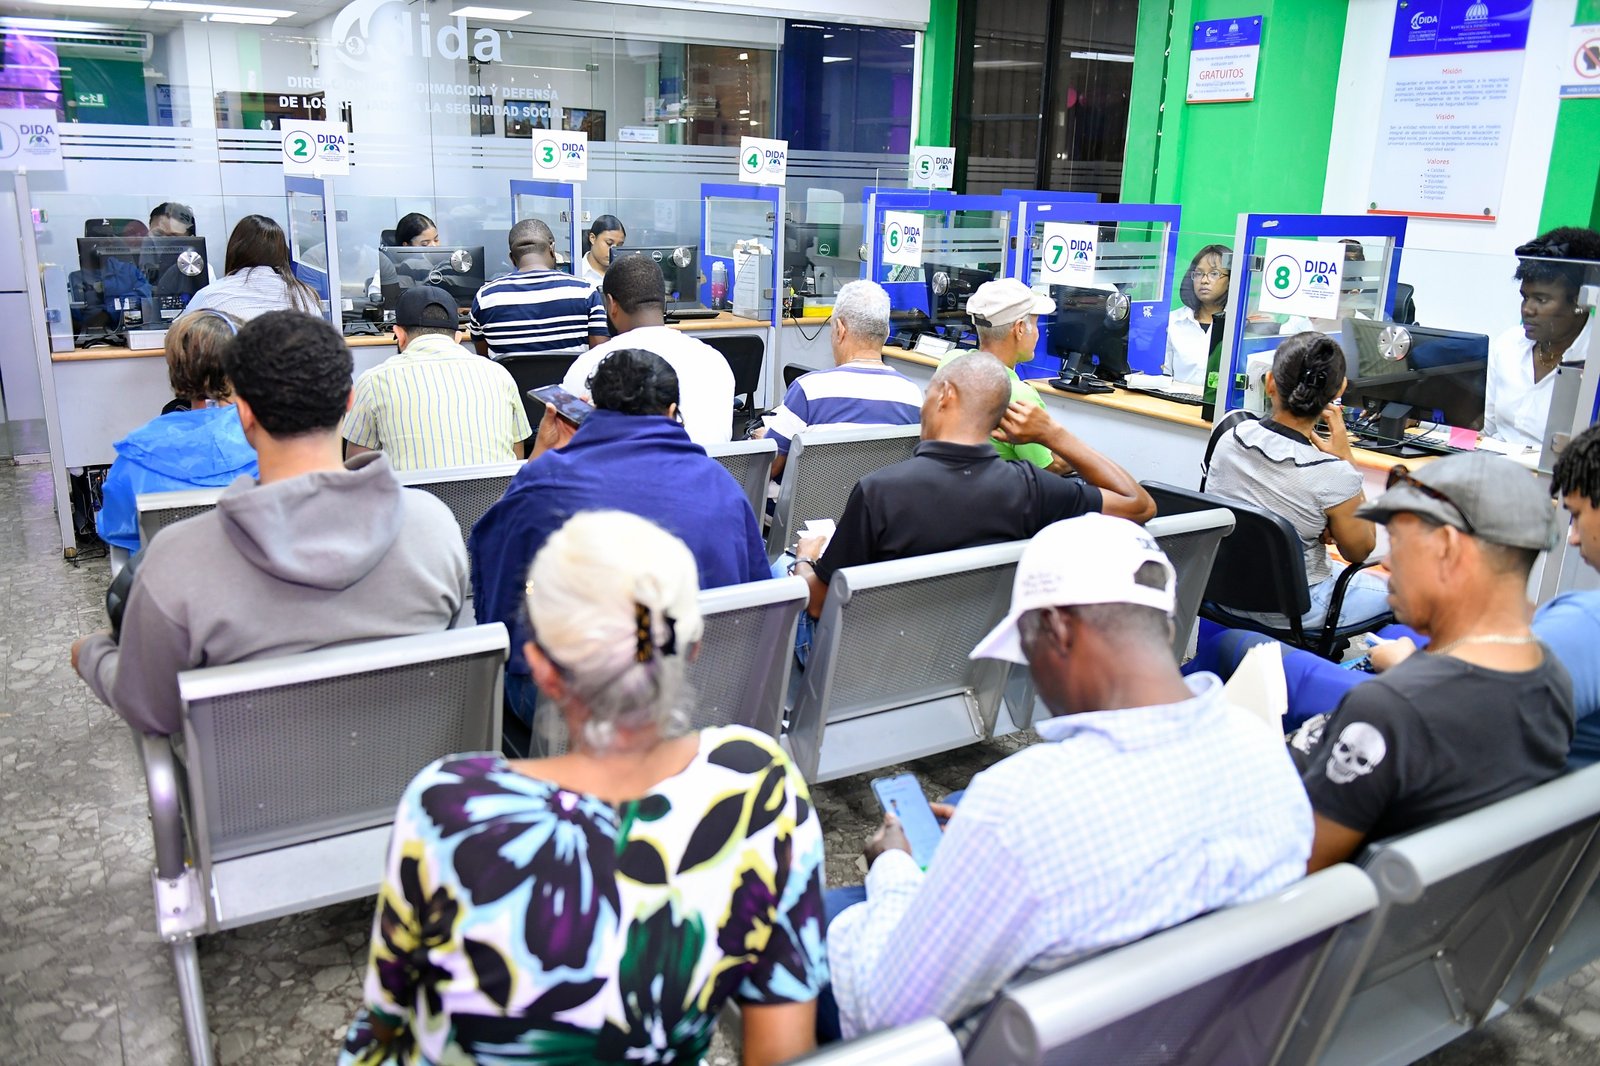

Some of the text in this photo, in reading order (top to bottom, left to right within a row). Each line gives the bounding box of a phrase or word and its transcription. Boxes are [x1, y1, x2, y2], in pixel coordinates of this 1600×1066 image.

[1419, 15, 1438, 25] DIDA
[1199, 68, 1244, 80] GRATUITOS
[490, 86, 498, 97] Y
[502, 87, 559, 100] DEFENSA
[279, 95, 298, 108] DE
[449, 103, 519, 117] SEGURIDAD
[522, 106, 568, 119] SOCIAL
[1436, 113, 1455, 121] Visión
[20, 124, 55, 135] DIDA
[317, 134, 345, 145] DIDA
[293, 138, 308, 156] 2
[561, 142, 585, 152] DIDA
[542, 146, 554, 163] 3
[747, 153, 758, 168] 4
[765, 149, 785, 160] DIDA
[935, 156, 953, 165] DIDA
[921, 160, 929, 175] 5
[904, 225, 920, 237] DIDA
[890, 230, 898, 247] 6
[1070, 239, 1093, 252] DIDA
[1052, 245, 1063, 265] 7
[1304, 260, 1338, 275] DIDA
[1274, 266, 1290, 290] 8
